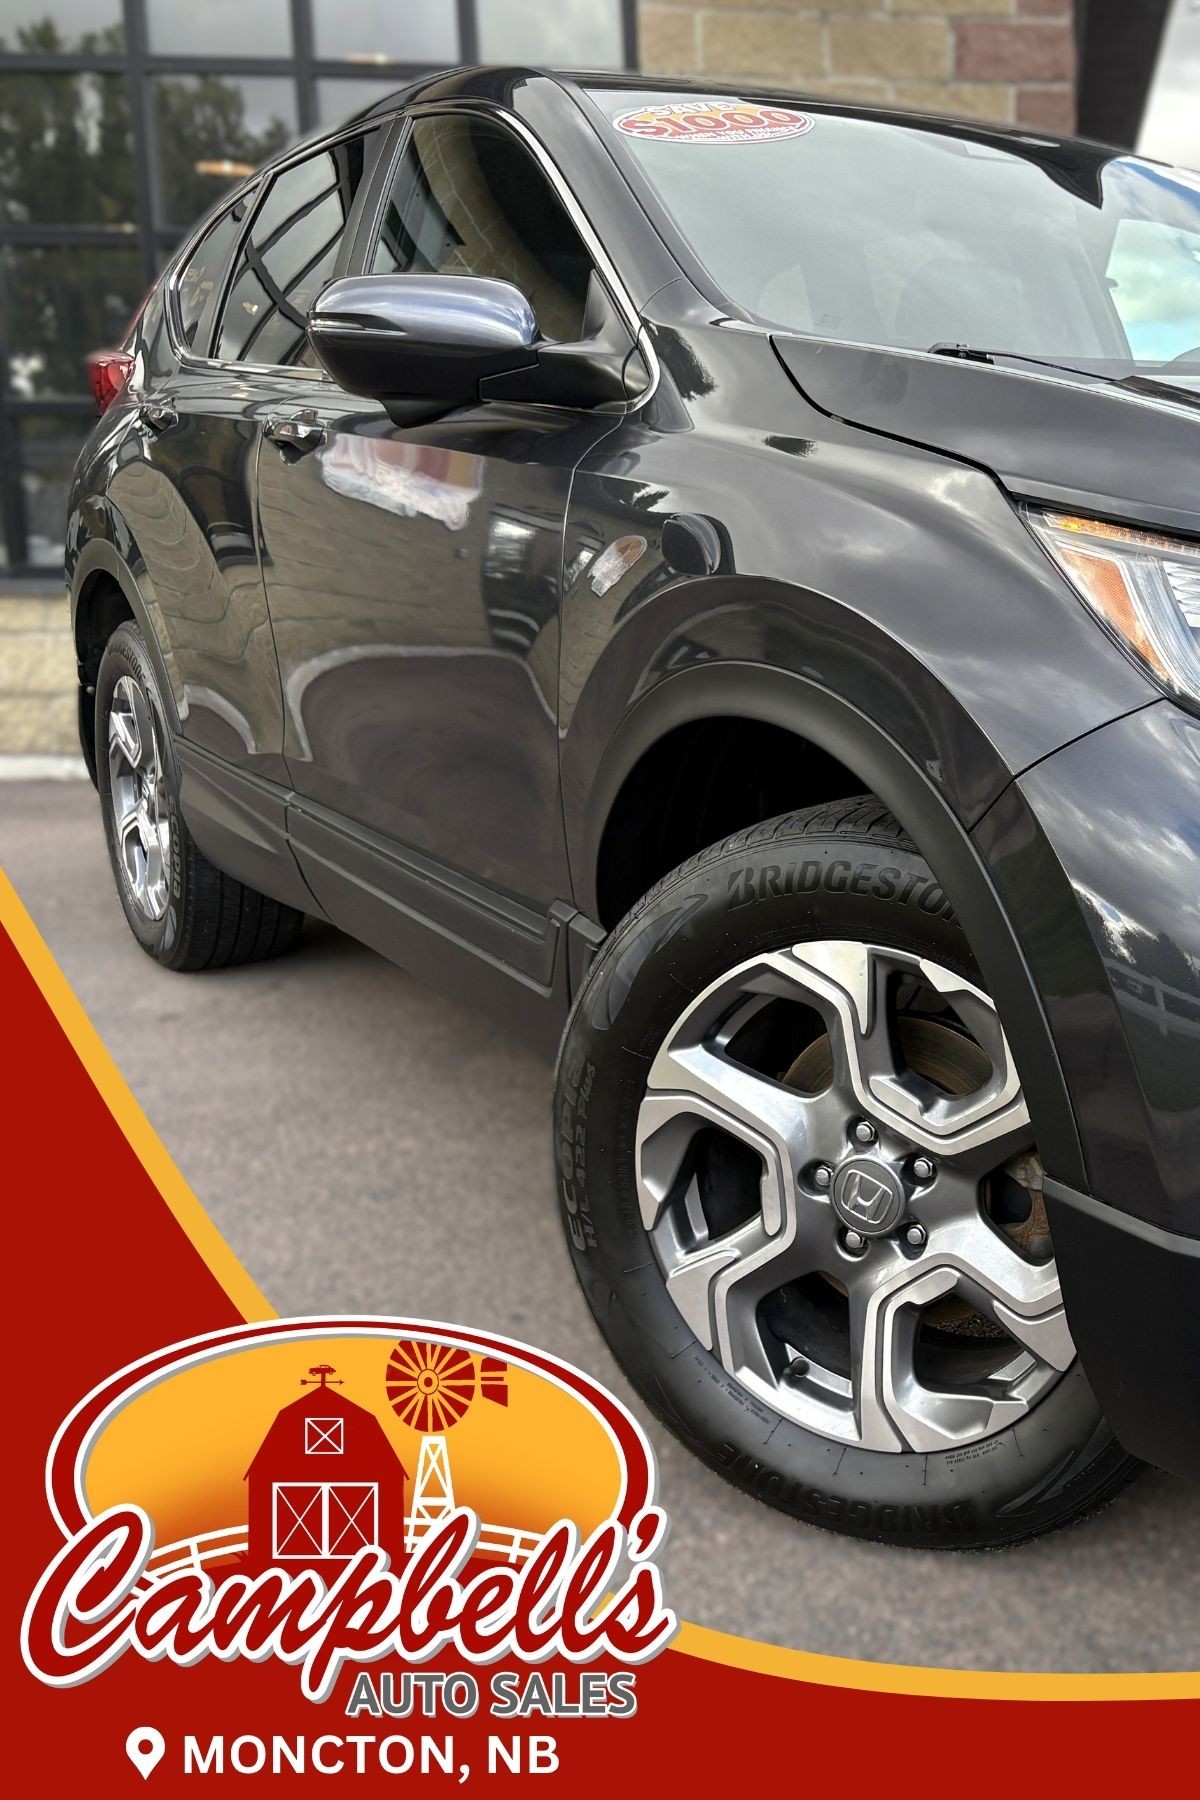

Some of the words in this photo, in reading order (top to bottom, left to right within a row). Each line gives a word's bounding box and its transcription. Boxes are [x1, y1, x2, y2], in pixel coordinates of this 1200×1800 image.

[647, 102, 734, 115] SAVE
[621, 110, 802, 138] $1000
[575, 1123, 587, 1188] 422
